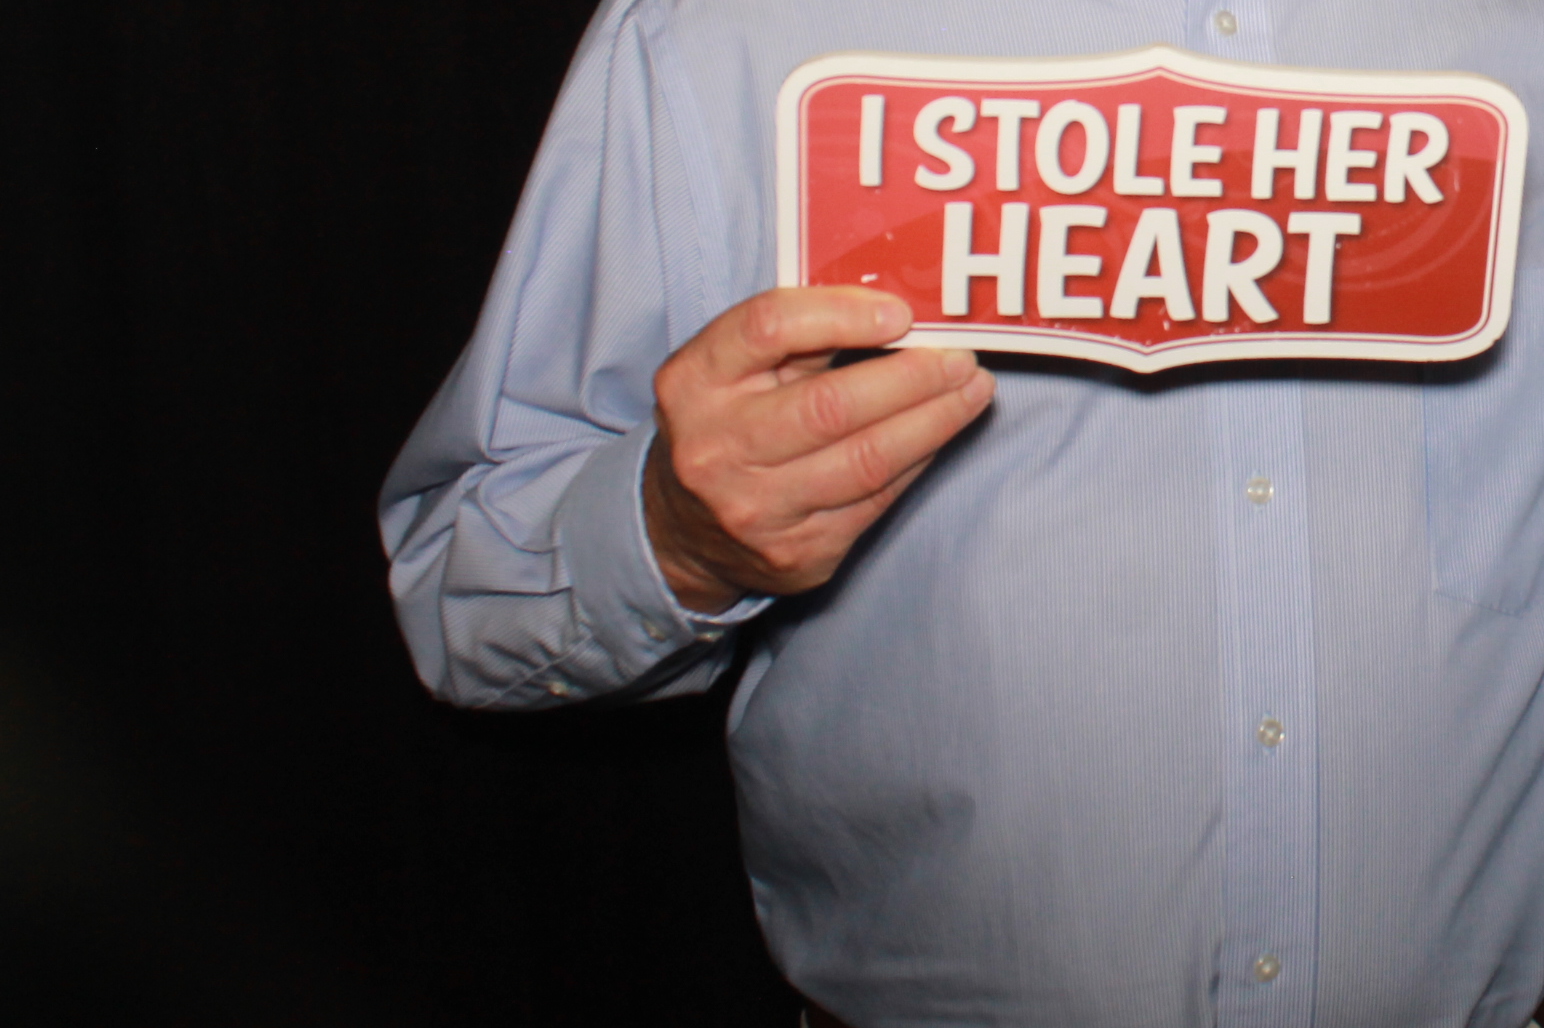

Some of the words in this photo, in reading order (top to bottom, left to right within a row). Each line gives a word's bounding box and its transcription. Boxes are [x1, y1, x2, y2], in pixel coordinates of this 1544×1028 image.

[858, 94, 884, 186] I
[912, 96, 1228, 198] STOLE
[1250, 107, 1450, 204] HER
[941, 201, 1362, 325] HEART
